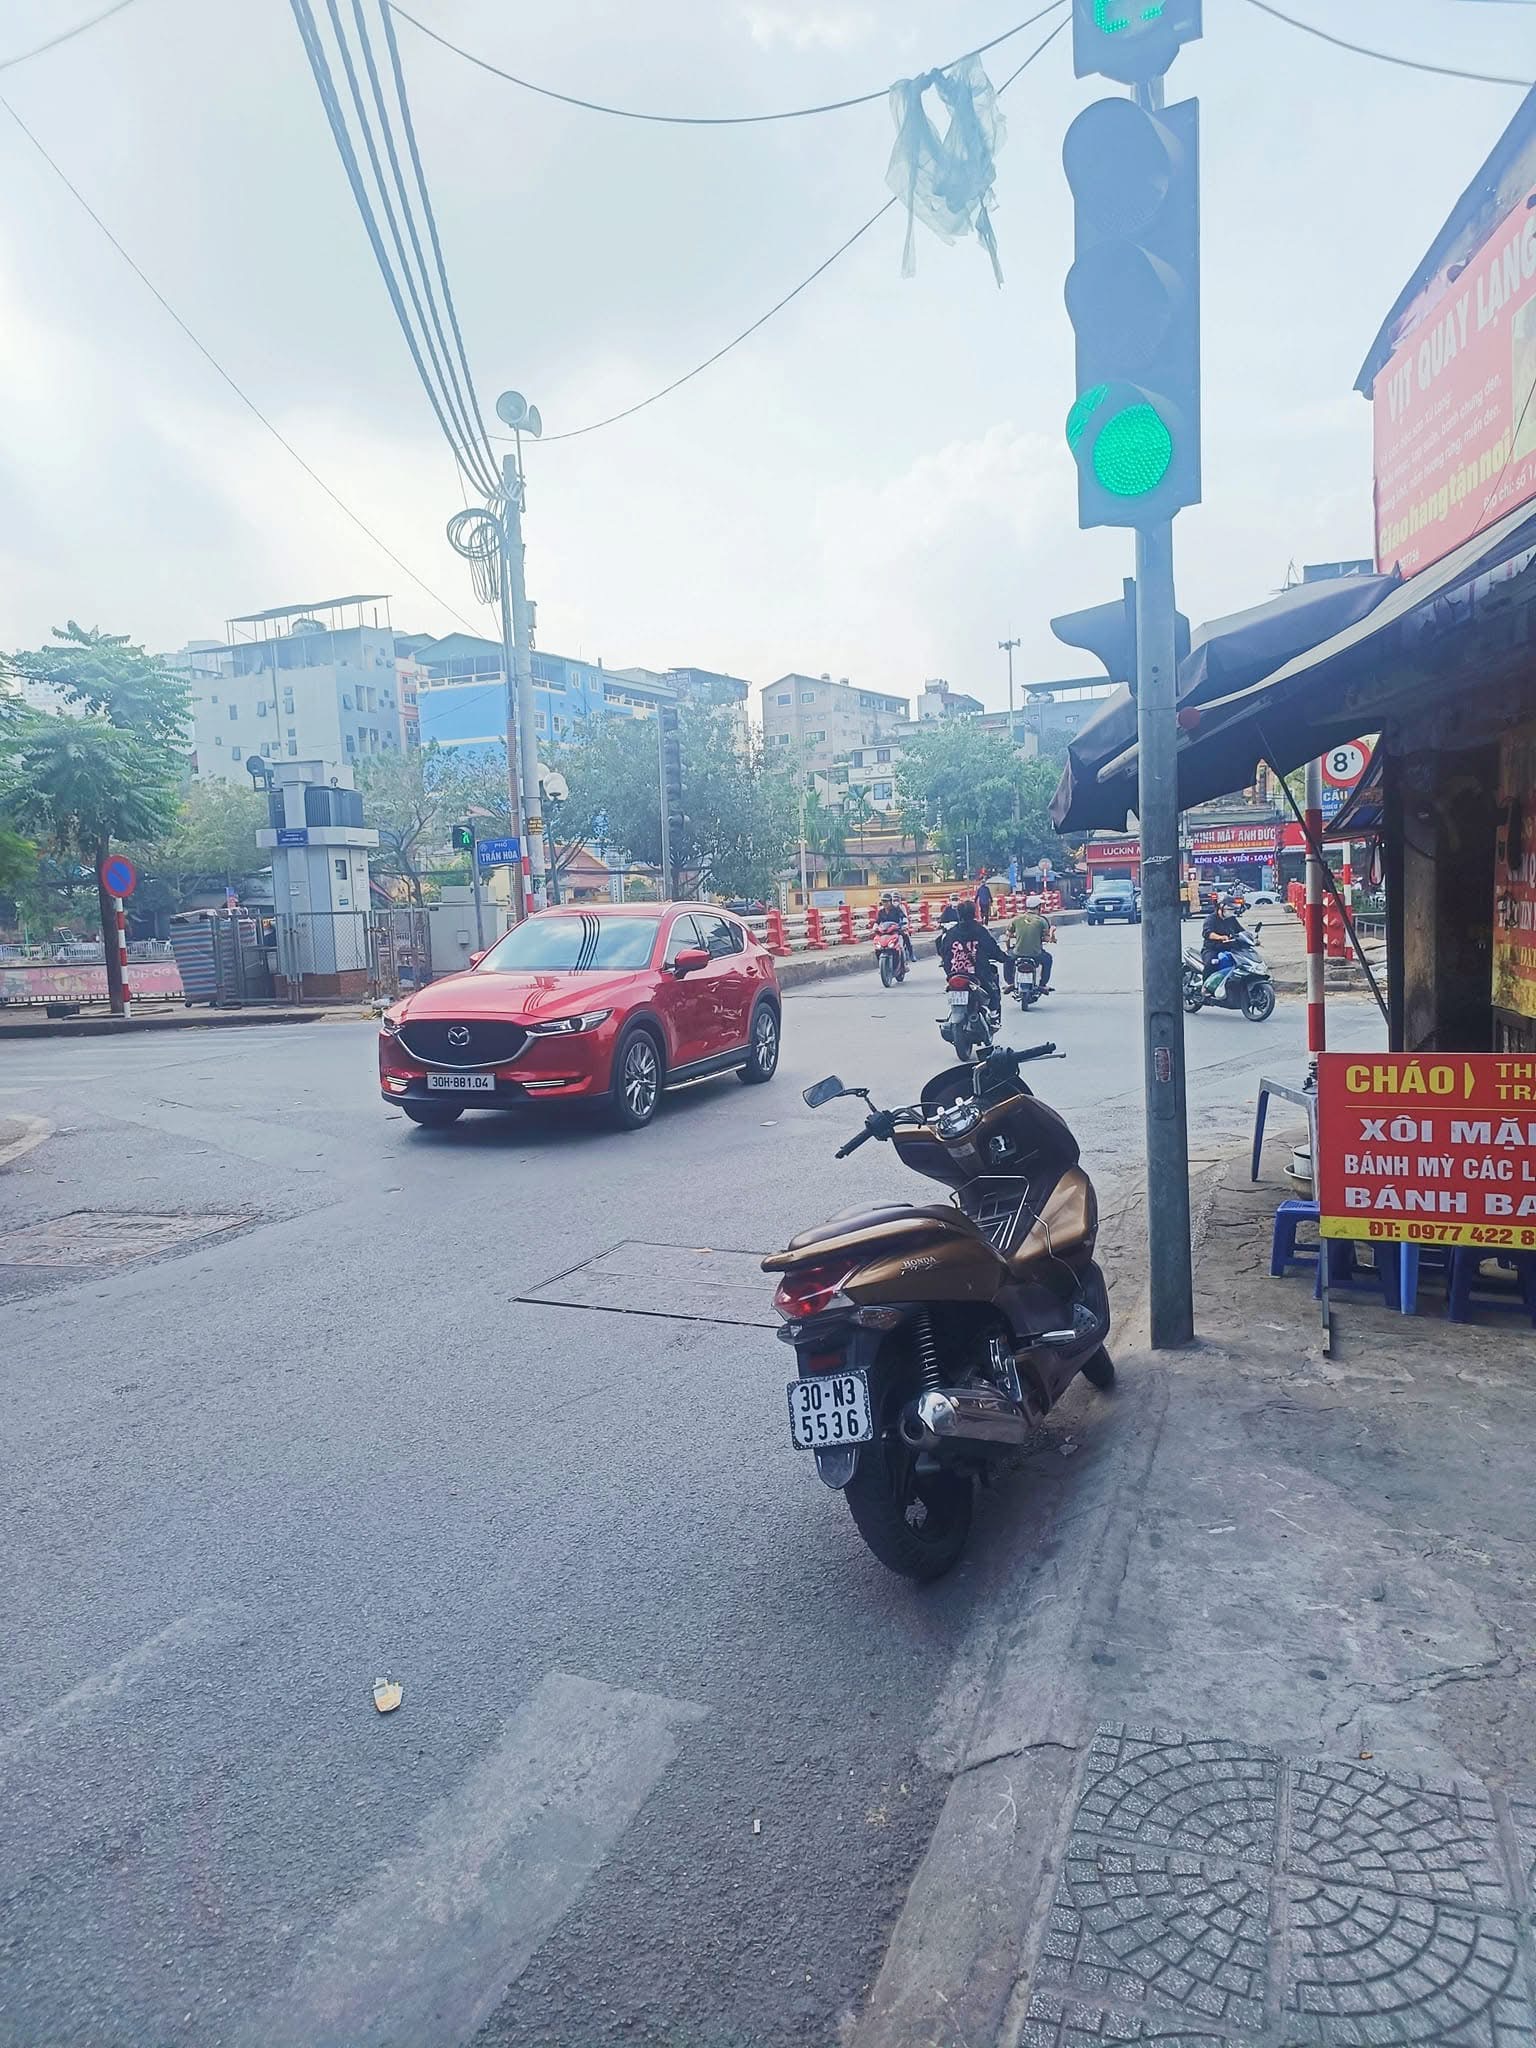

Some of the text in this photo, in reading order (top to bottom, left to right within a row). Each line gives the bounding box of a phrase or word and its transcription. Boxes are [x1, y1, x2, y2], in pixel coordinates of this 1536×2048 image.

[1417, 290, 1469, 391] QUAY
[1238, 830, 1256, 841] ANH
[1346, 1060, 1455, 1095] CHÁO
[1359, 1114, 1434, 1143] XÔI
[1344, 1150, 1409, 1177] BÁNH
[1417, 1153, 1455, 1179] MỲ
[1463, 1154, 1513, 1181] CÁC
[1344, 1184, 1468, 1214] BÁNH
[1369, 1221, 1401, 1238] ĐT:
[1407, 1223, 1463, 1241] 0977
[1470, 1226, 1514, 1245] 422
[902, 1256, 937, 1268] HONDA
[801, 1408, 859, 1443] 5536
